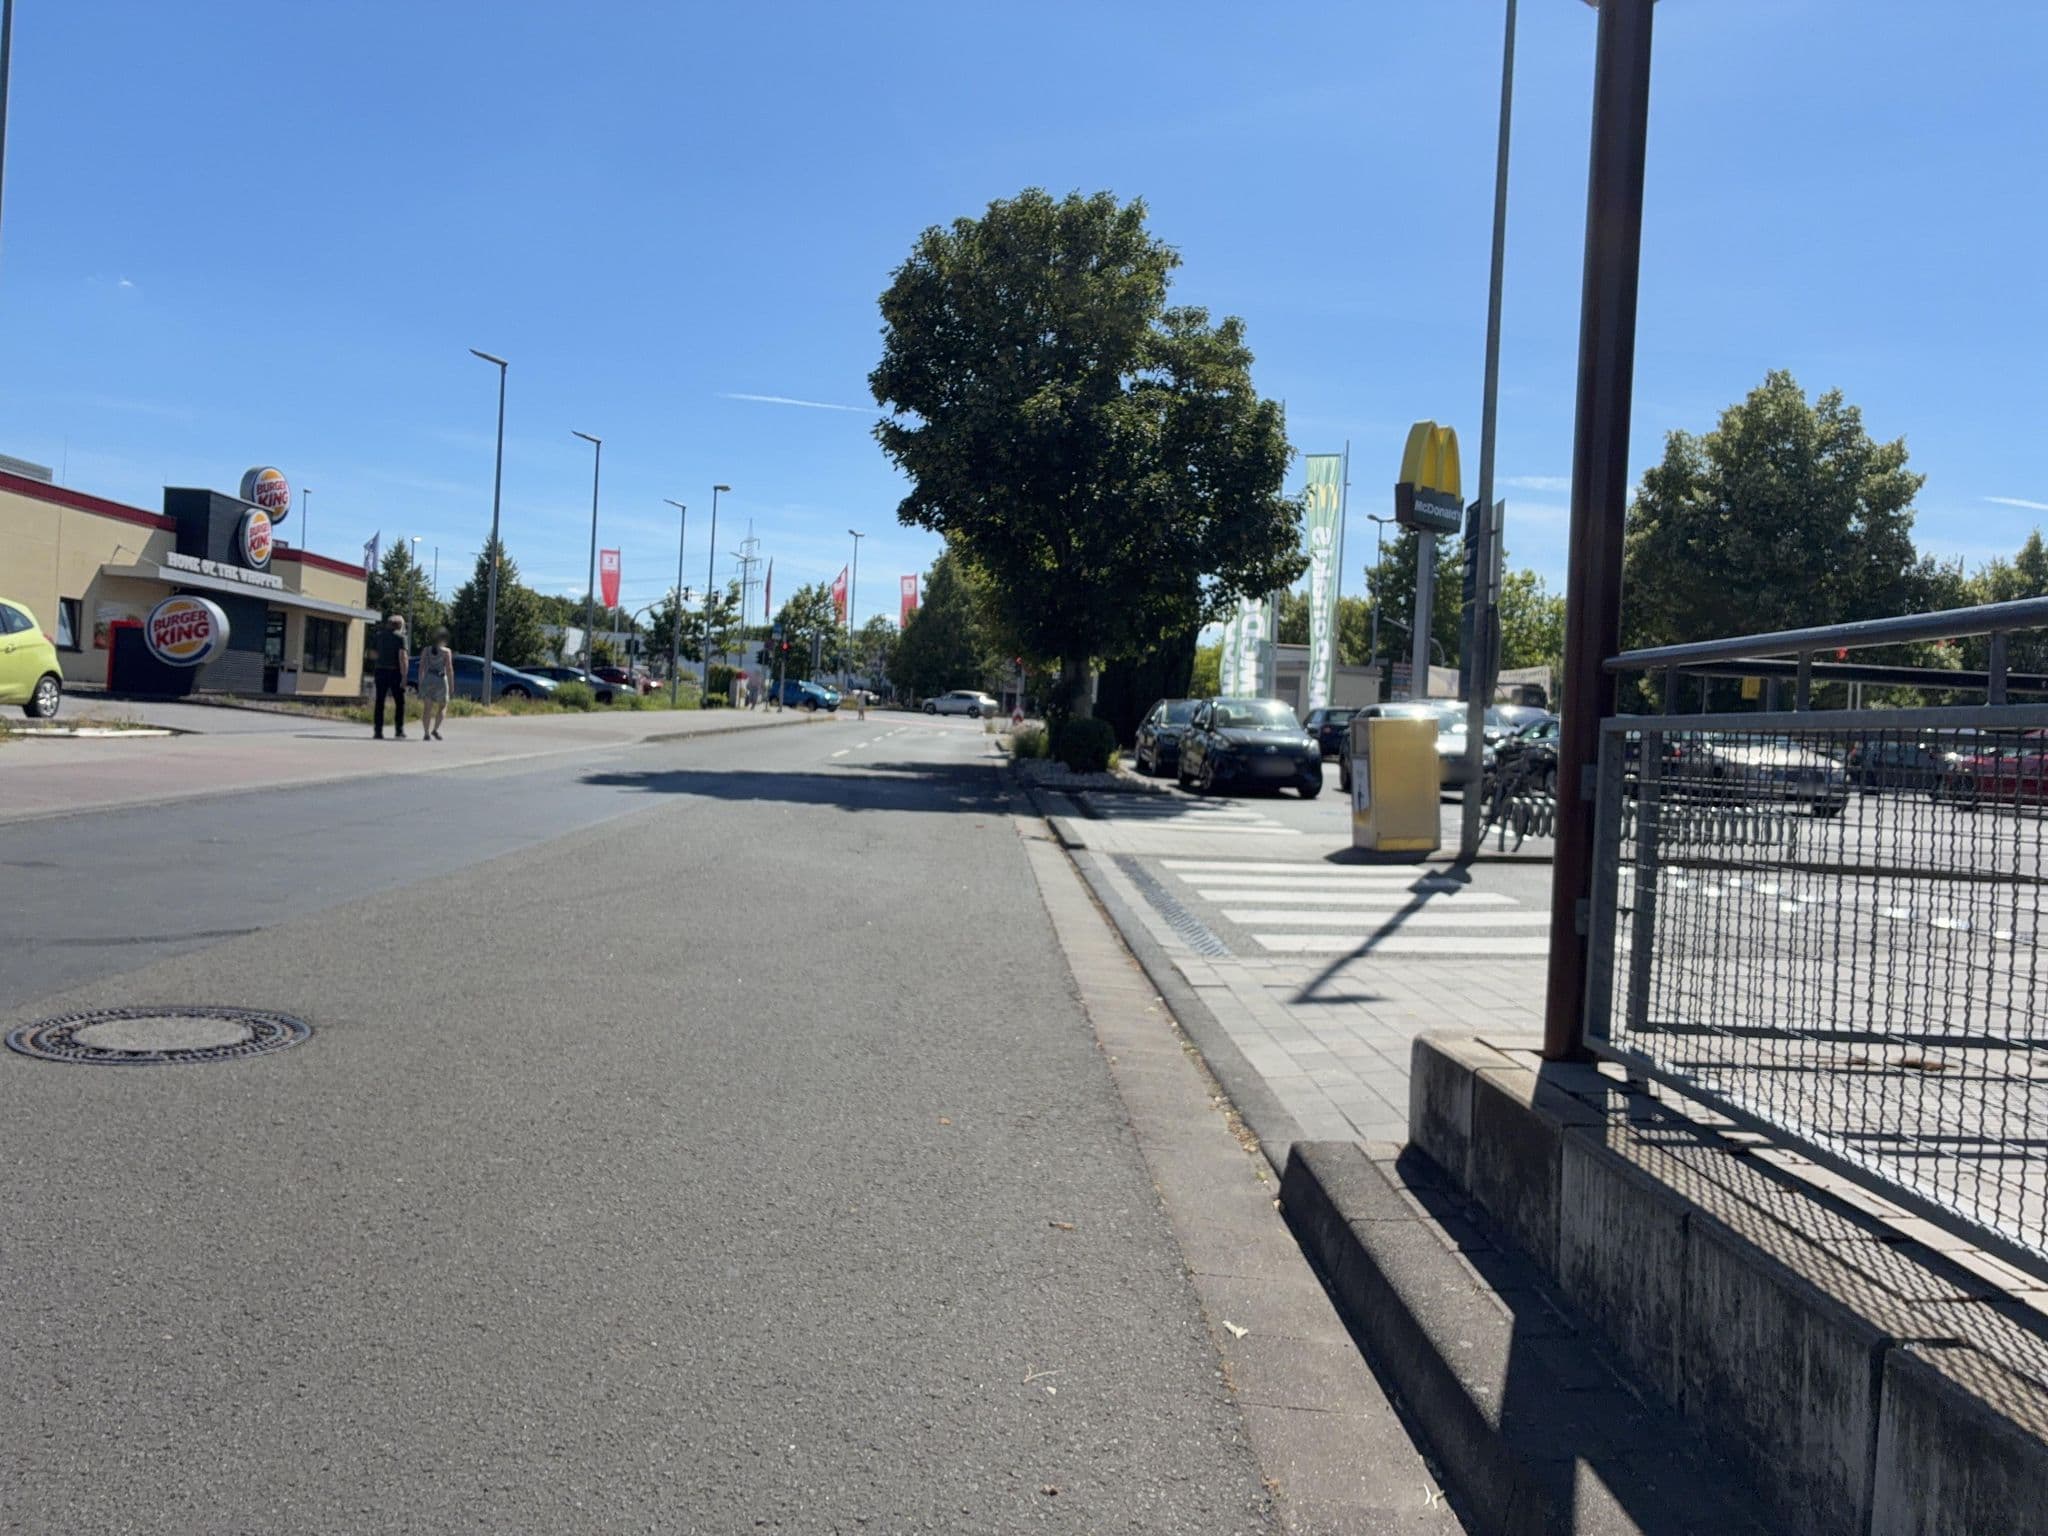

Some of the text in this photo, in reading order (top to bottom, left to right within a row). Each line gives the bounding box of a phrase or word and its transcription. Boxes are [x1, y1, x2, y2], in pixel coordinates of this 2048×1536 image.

[256, 480, 287, 496] BURGER
[257, 491, 289, 507] KING
[1414, 499, 1462, 521] McDonald's
[167, 551, 283, 590] HOME OF THE WHOPPER
[153, 610, 208, 633] BURGER
[155, 622, 209, 650] KING
